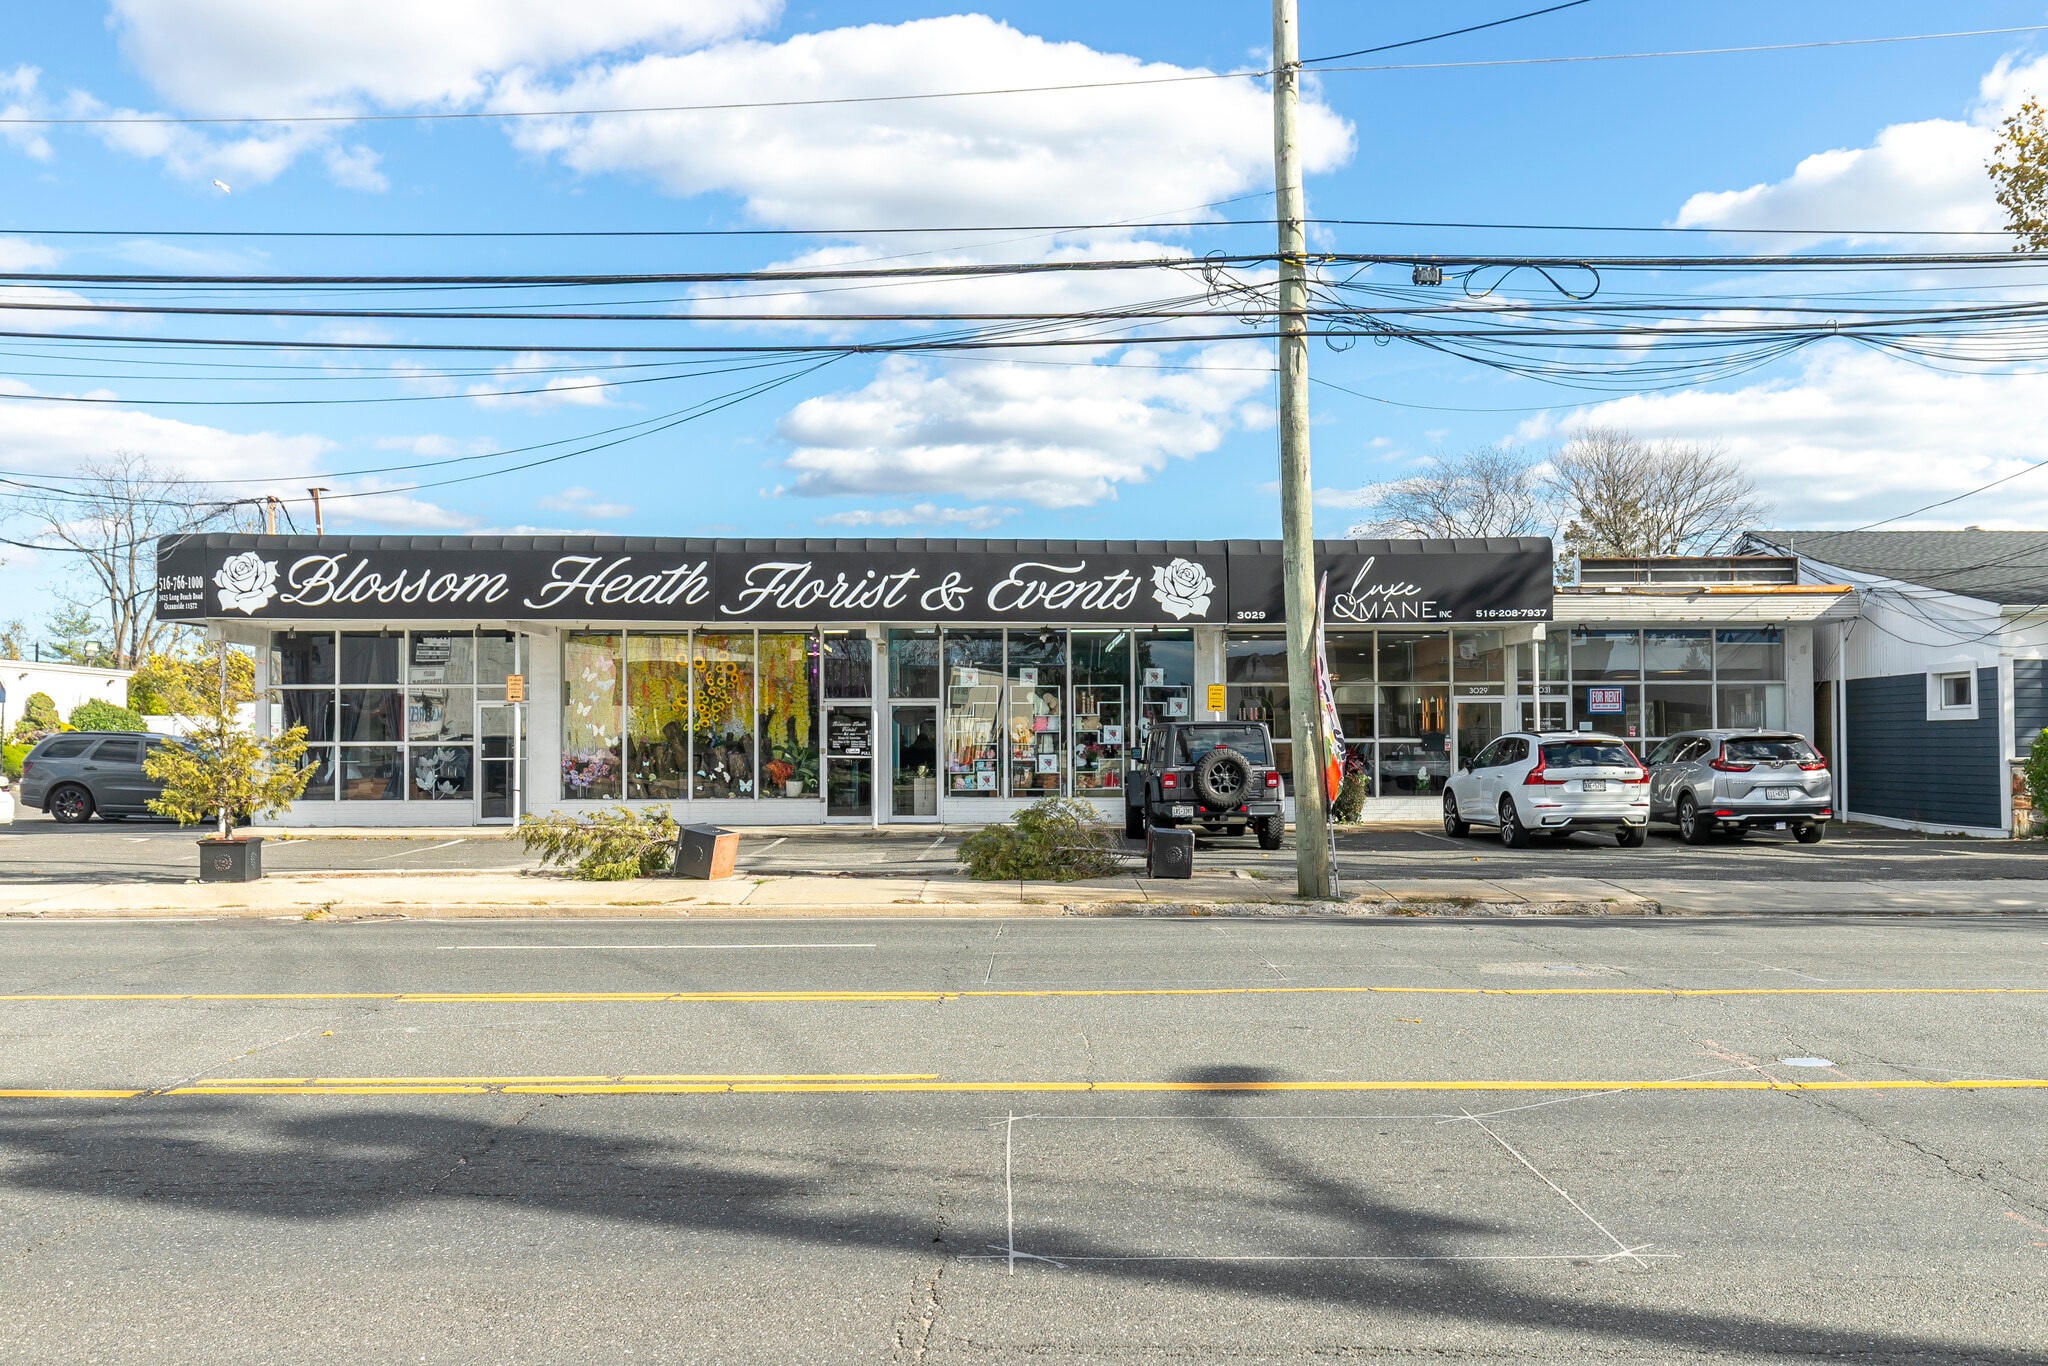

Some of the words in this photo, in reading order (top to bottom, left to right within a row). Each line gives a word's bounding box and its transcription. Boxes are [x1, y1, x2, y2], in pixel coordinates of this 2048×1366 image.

[158, 575, 204, 591] 516-766-1000
[280, 553, 509, 606] Blossom
[523, 556, 709, 609] Heath
[720, 561, 920, 615] Florist
[920, 571, 973, 611] &
[987, 560, 1142, 611] Events
[1237, 611, 1266, 620] 3029
[1475, 609, 1547, 618] 516-208-7937
[1592, 691, 1604, 703] FOR
[1604, 691, 1620, 703] RENT
